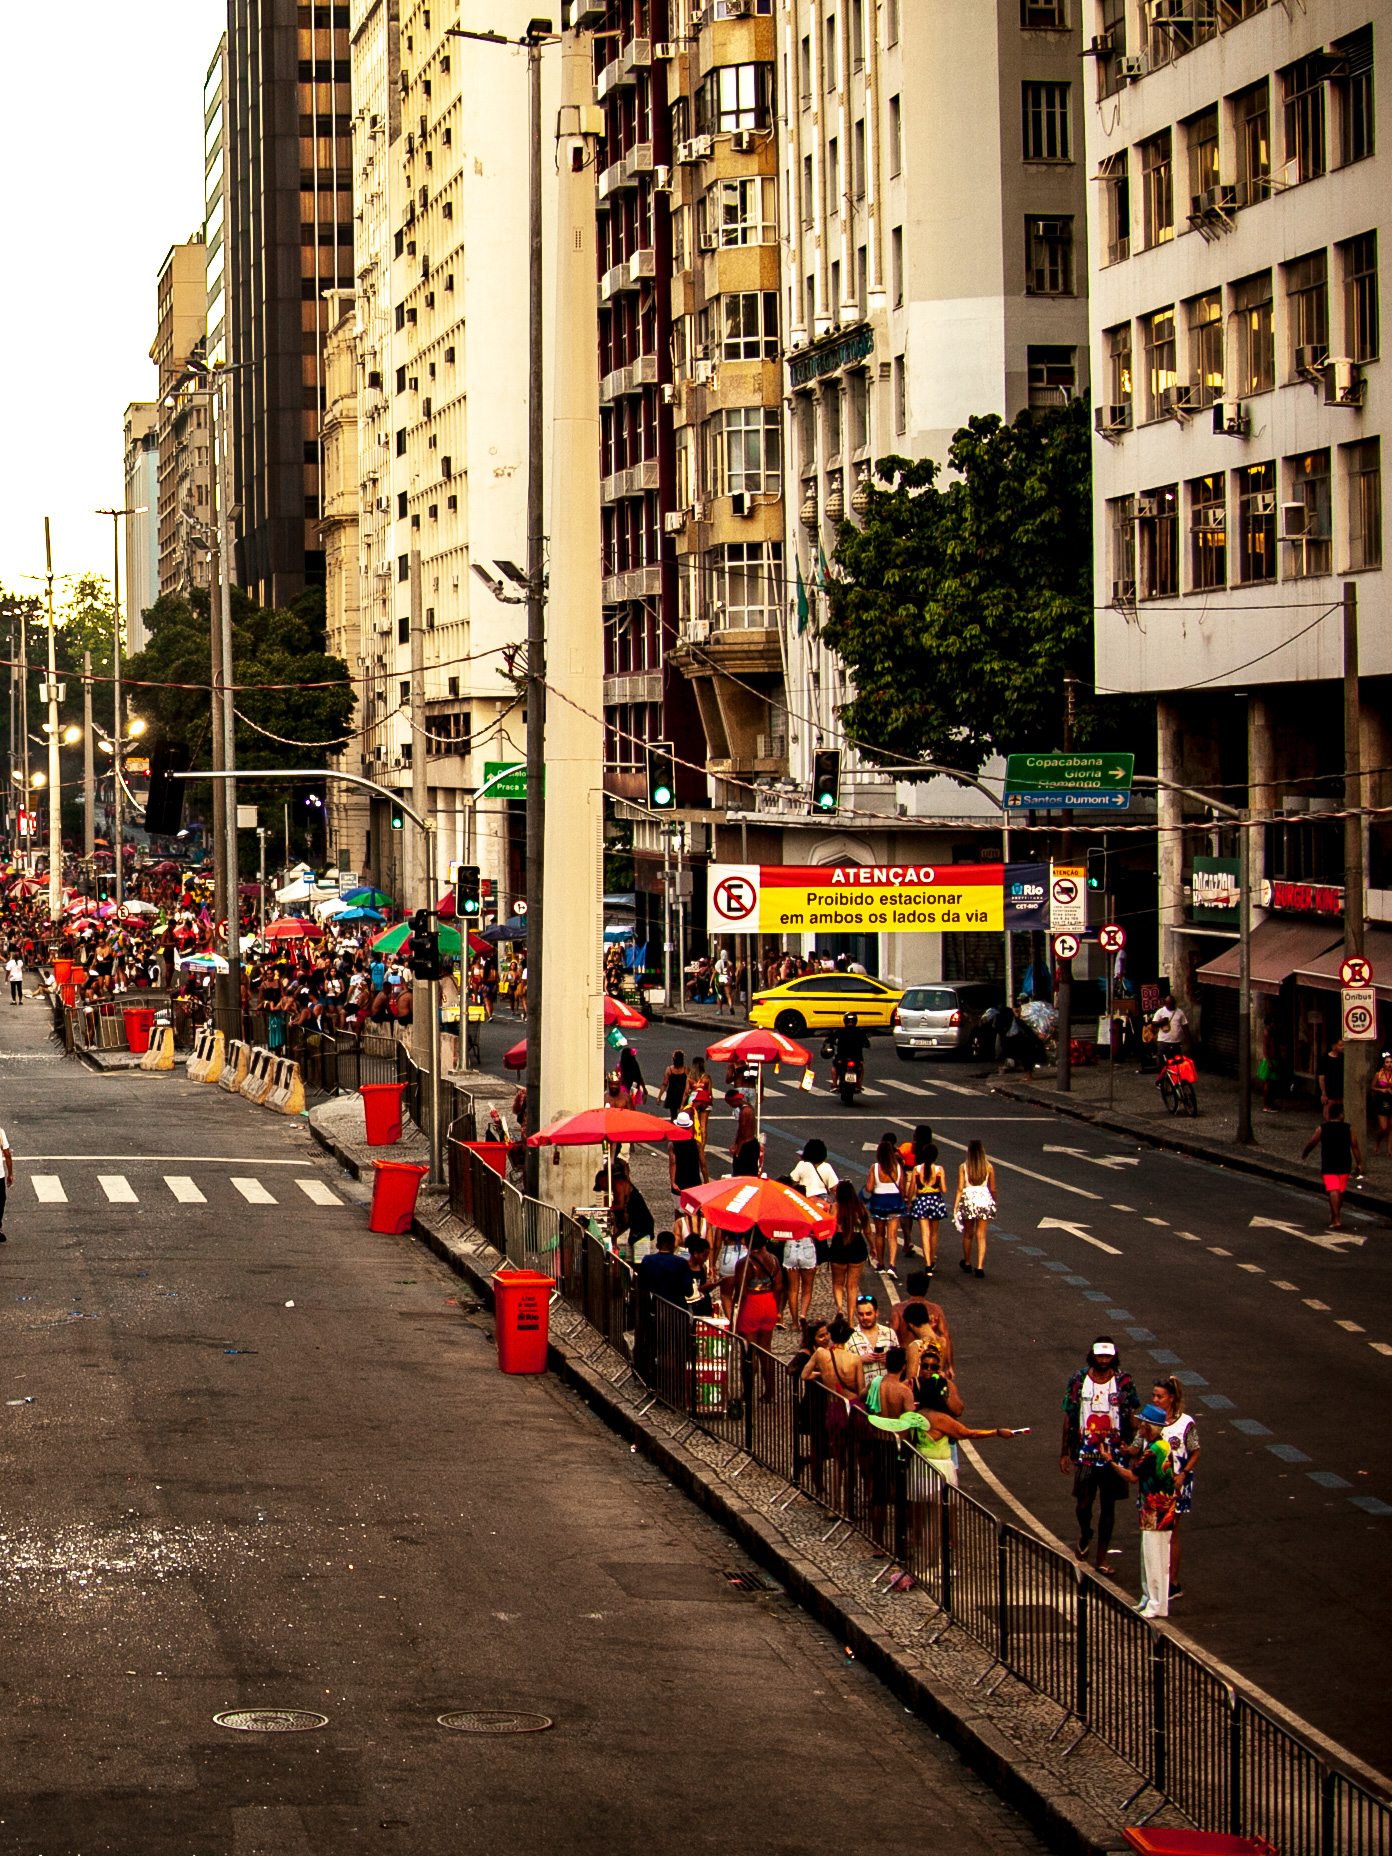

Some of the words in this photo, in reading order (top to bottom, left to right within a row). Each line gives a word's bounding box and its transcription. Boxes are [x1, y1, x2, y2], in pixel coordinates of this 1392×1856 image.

[1026, 757, 1102, 768] Copacabana
[1023, 795, 1063, 804] Santos
[1065, 795, 1109, 804] Dumont
[831, 866, 935, 887] ATENÇÃO
[1023, 884, 1043, 895] Rio
[806, 892, 875, 906] Proibido
[879, 893, 963, 906] estacionar
[1274, 883, 1312, 909] BURGER
[1315, 888, 1340, 913] KING
[780, 913, 804, 925] em
[809, 911, 863, 925] ambos
[868, 912, 888, 924] os
[892, 910, 936, 924] lados
[940, 910, 960, 923] da
[965, 910, 988, 923] via
[1344, 992, 1372, 1001] Ônibus
[1351, 1012, 1367, 1023] 50
